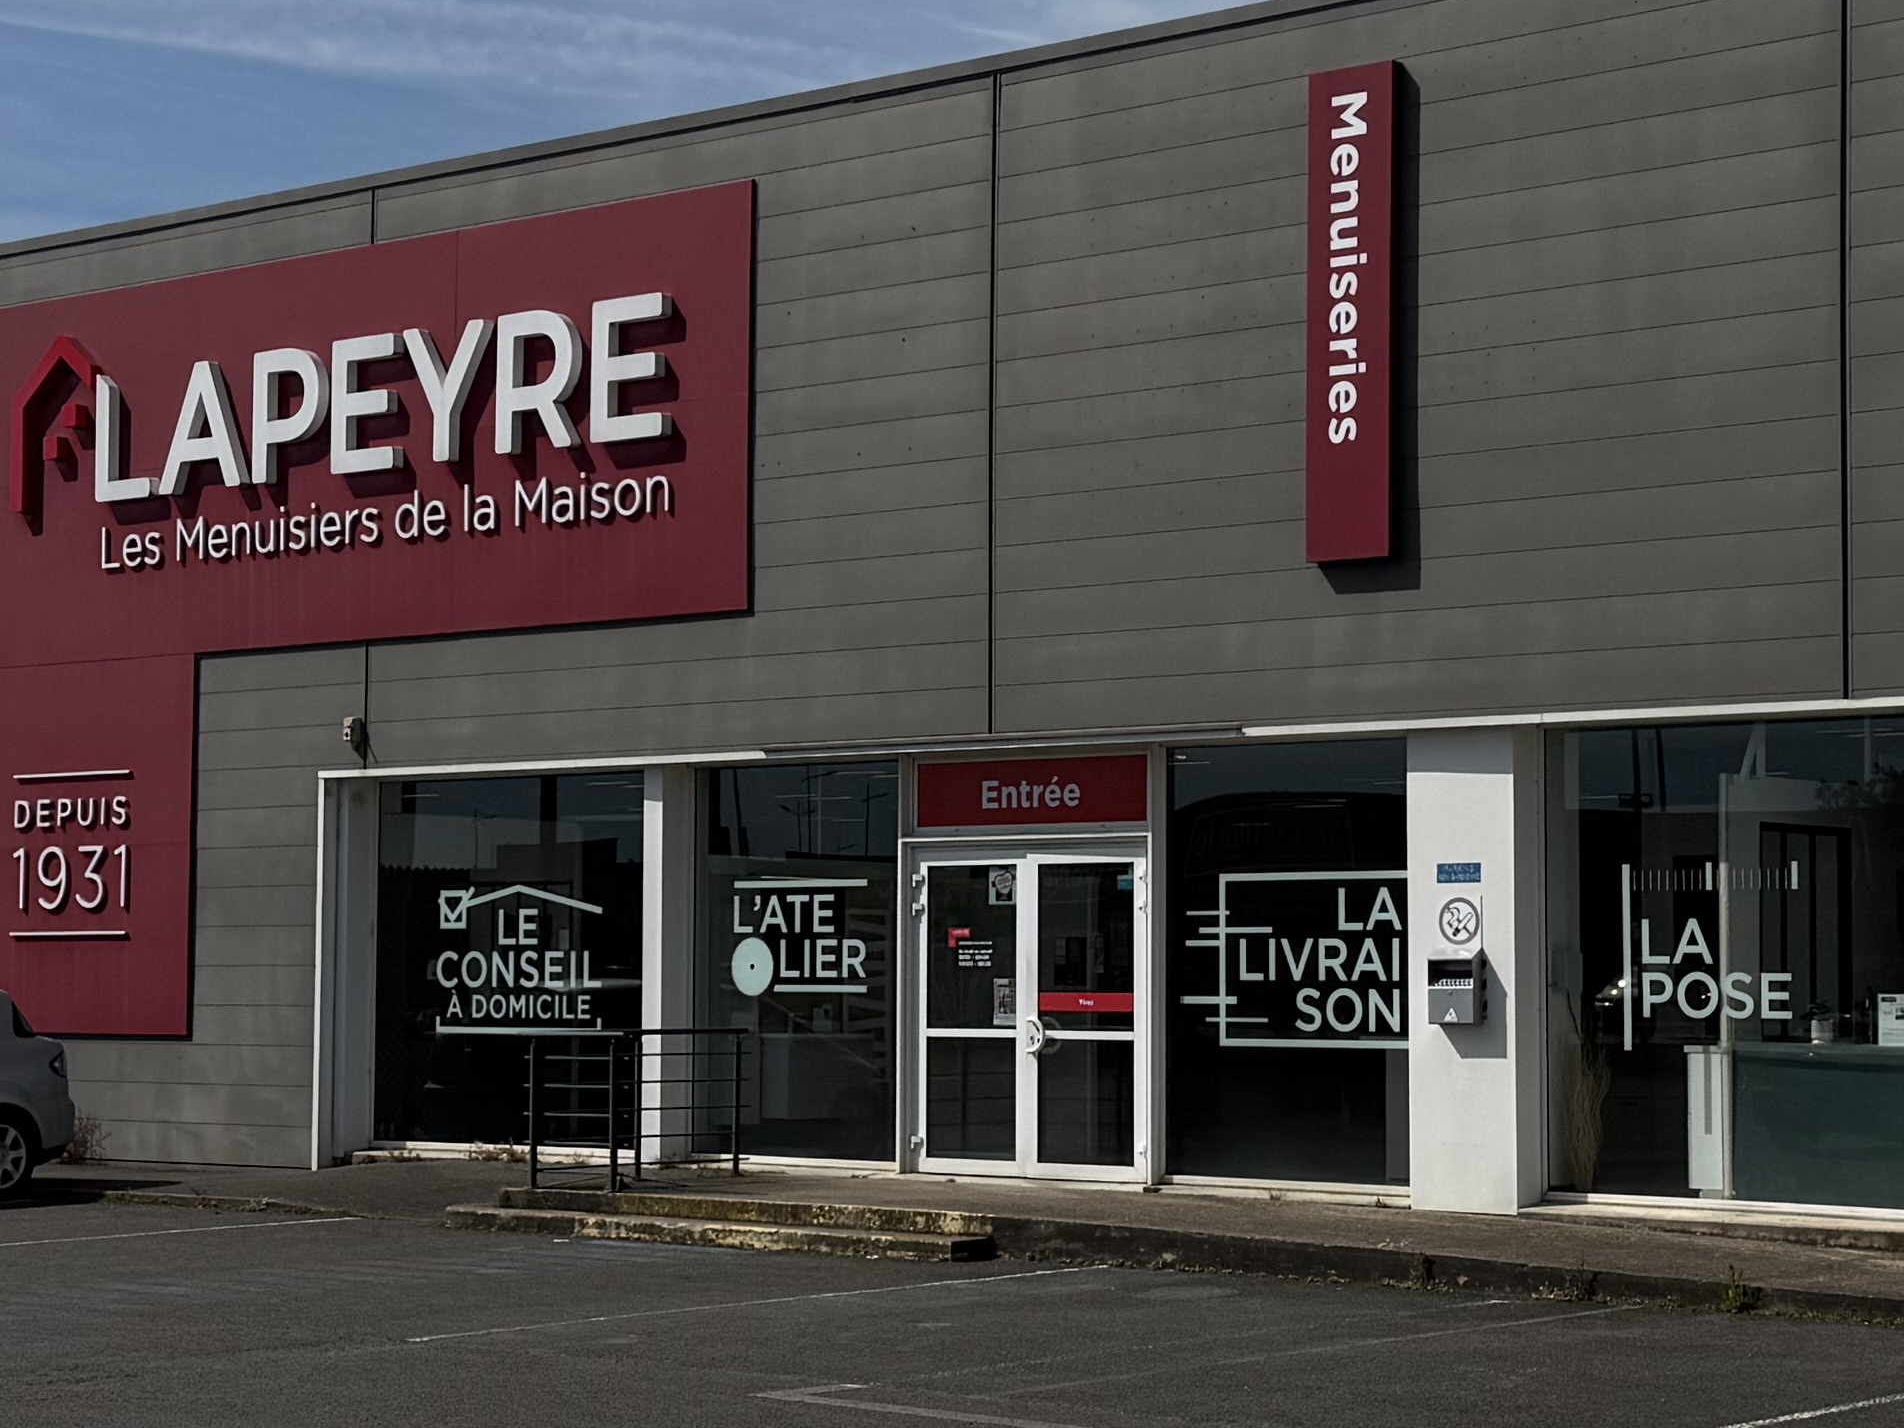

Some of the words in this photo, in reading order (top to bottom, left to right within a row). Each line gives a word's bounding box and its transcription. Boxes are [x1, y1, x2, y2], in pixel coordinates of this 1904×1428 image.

[1328, 91, 1368, 444] Menuiseries
[95, 291, 672, 503] LAPEYRE
[101, 526, 161, 569] Les
[176, 502, 379, 562] Menuisiers
[394, 489, 446, 539] de
[463, 483, 495, 532] la
[514, 471, 669, 527] Maison
[13, 795, 128, 829] DEPUIS
[981, 775, 1081, 810] Entrée
[12, 844, 130, 910] 1931
[498, 908, 539, 945] LE
[733, 893, 835, 934] L'ATE
[1337, 886, 1403, 931] LA
[1239, 937, 1400, 982] LIVRAI
[1641, 917, 1714, 965] LA
[436, 950, 602, 988] CONSEIL
[446, 988, 463, 1019] À
[471, 993, 591, 1020] DOMICILE
[1295, 987, 1401, 1033] SON
[1641, 971, 1793, 1021] POSE
